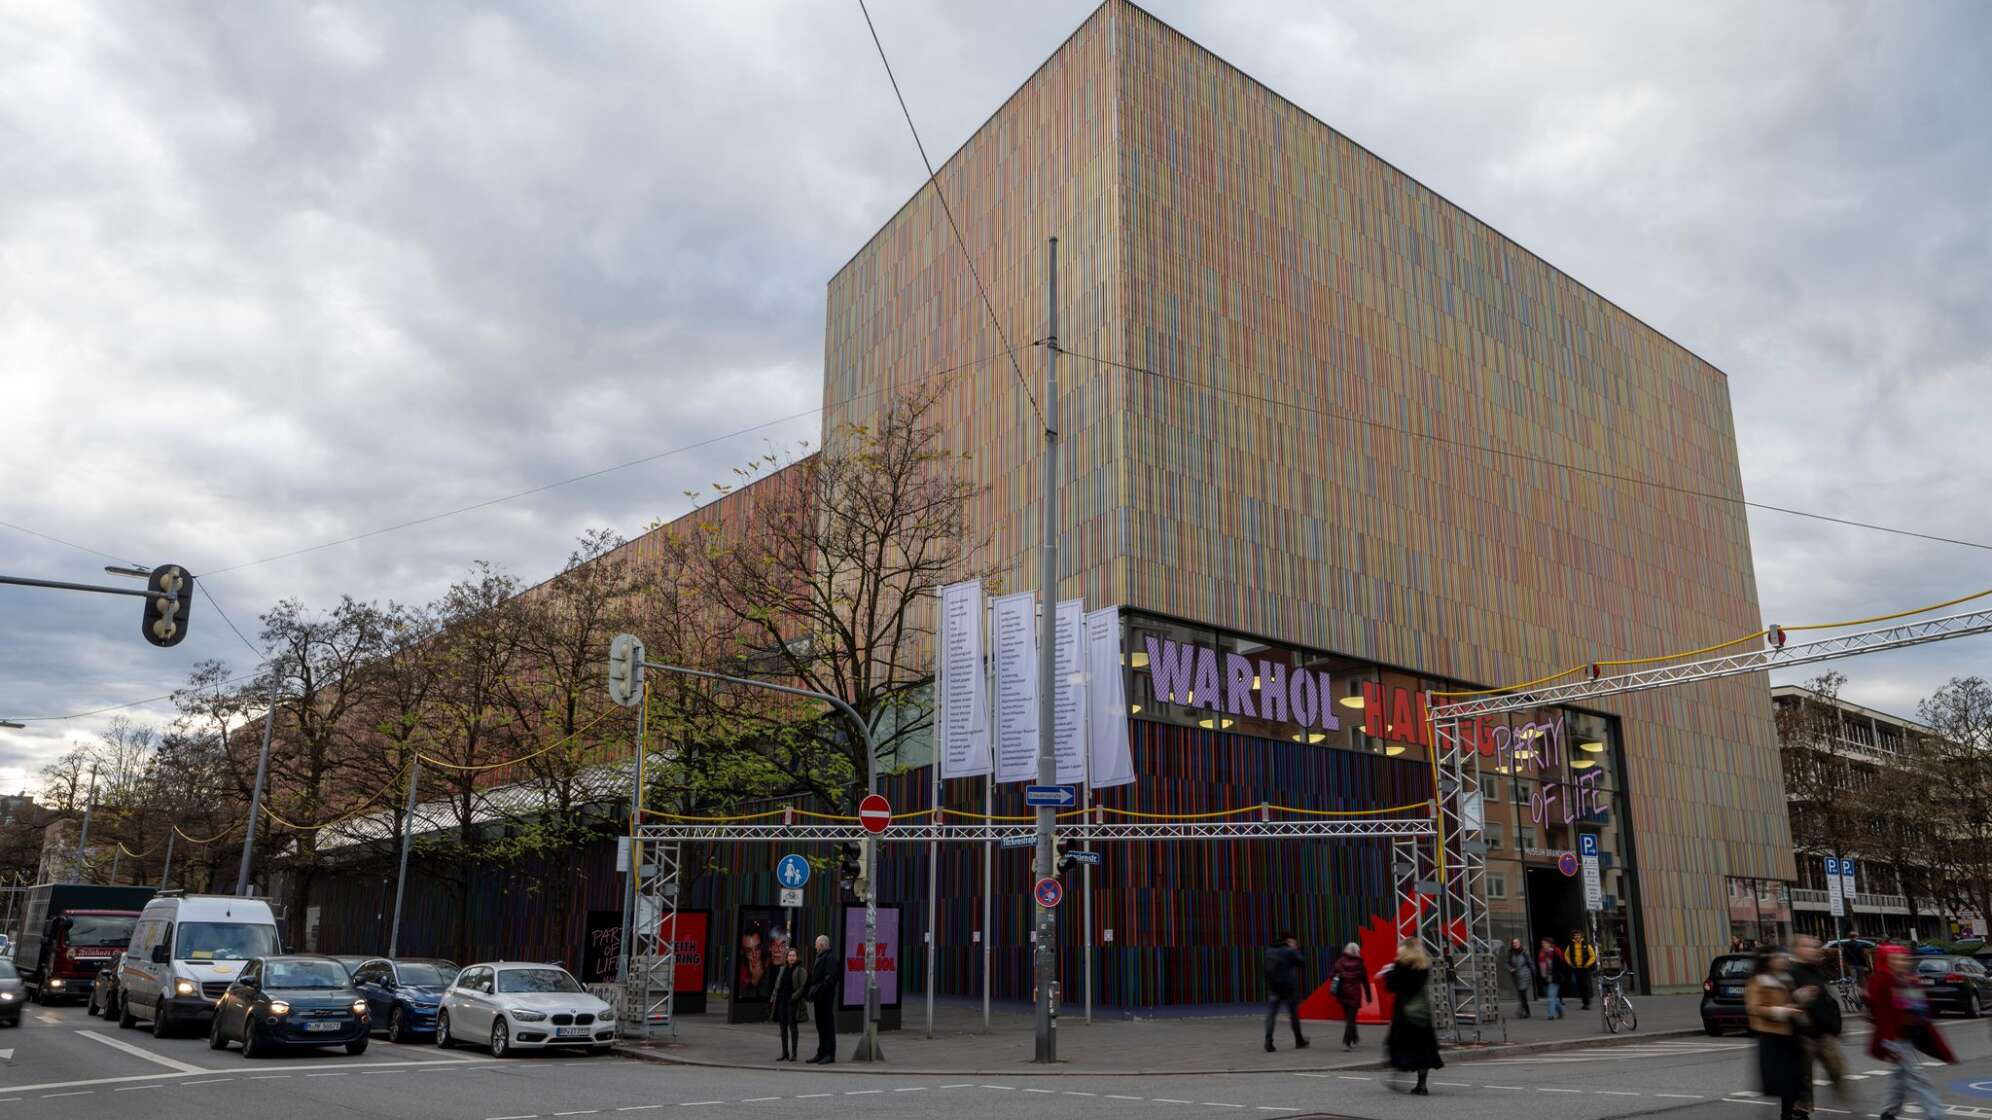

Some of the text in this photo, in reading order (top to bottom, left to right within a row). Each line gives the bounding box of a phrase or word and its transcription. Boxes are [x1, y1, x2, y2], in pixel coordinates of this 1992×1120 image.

[1144, 634, 1340, 730] WARHOL
[1492, 716, 1564, 777] PARTY
[1531, 770, 1608, 830] OF LIFE
[1583, 837, 1593, 854] P
[668, 941, 696, 952] EITH
[674, 954, 701, 966] RING
